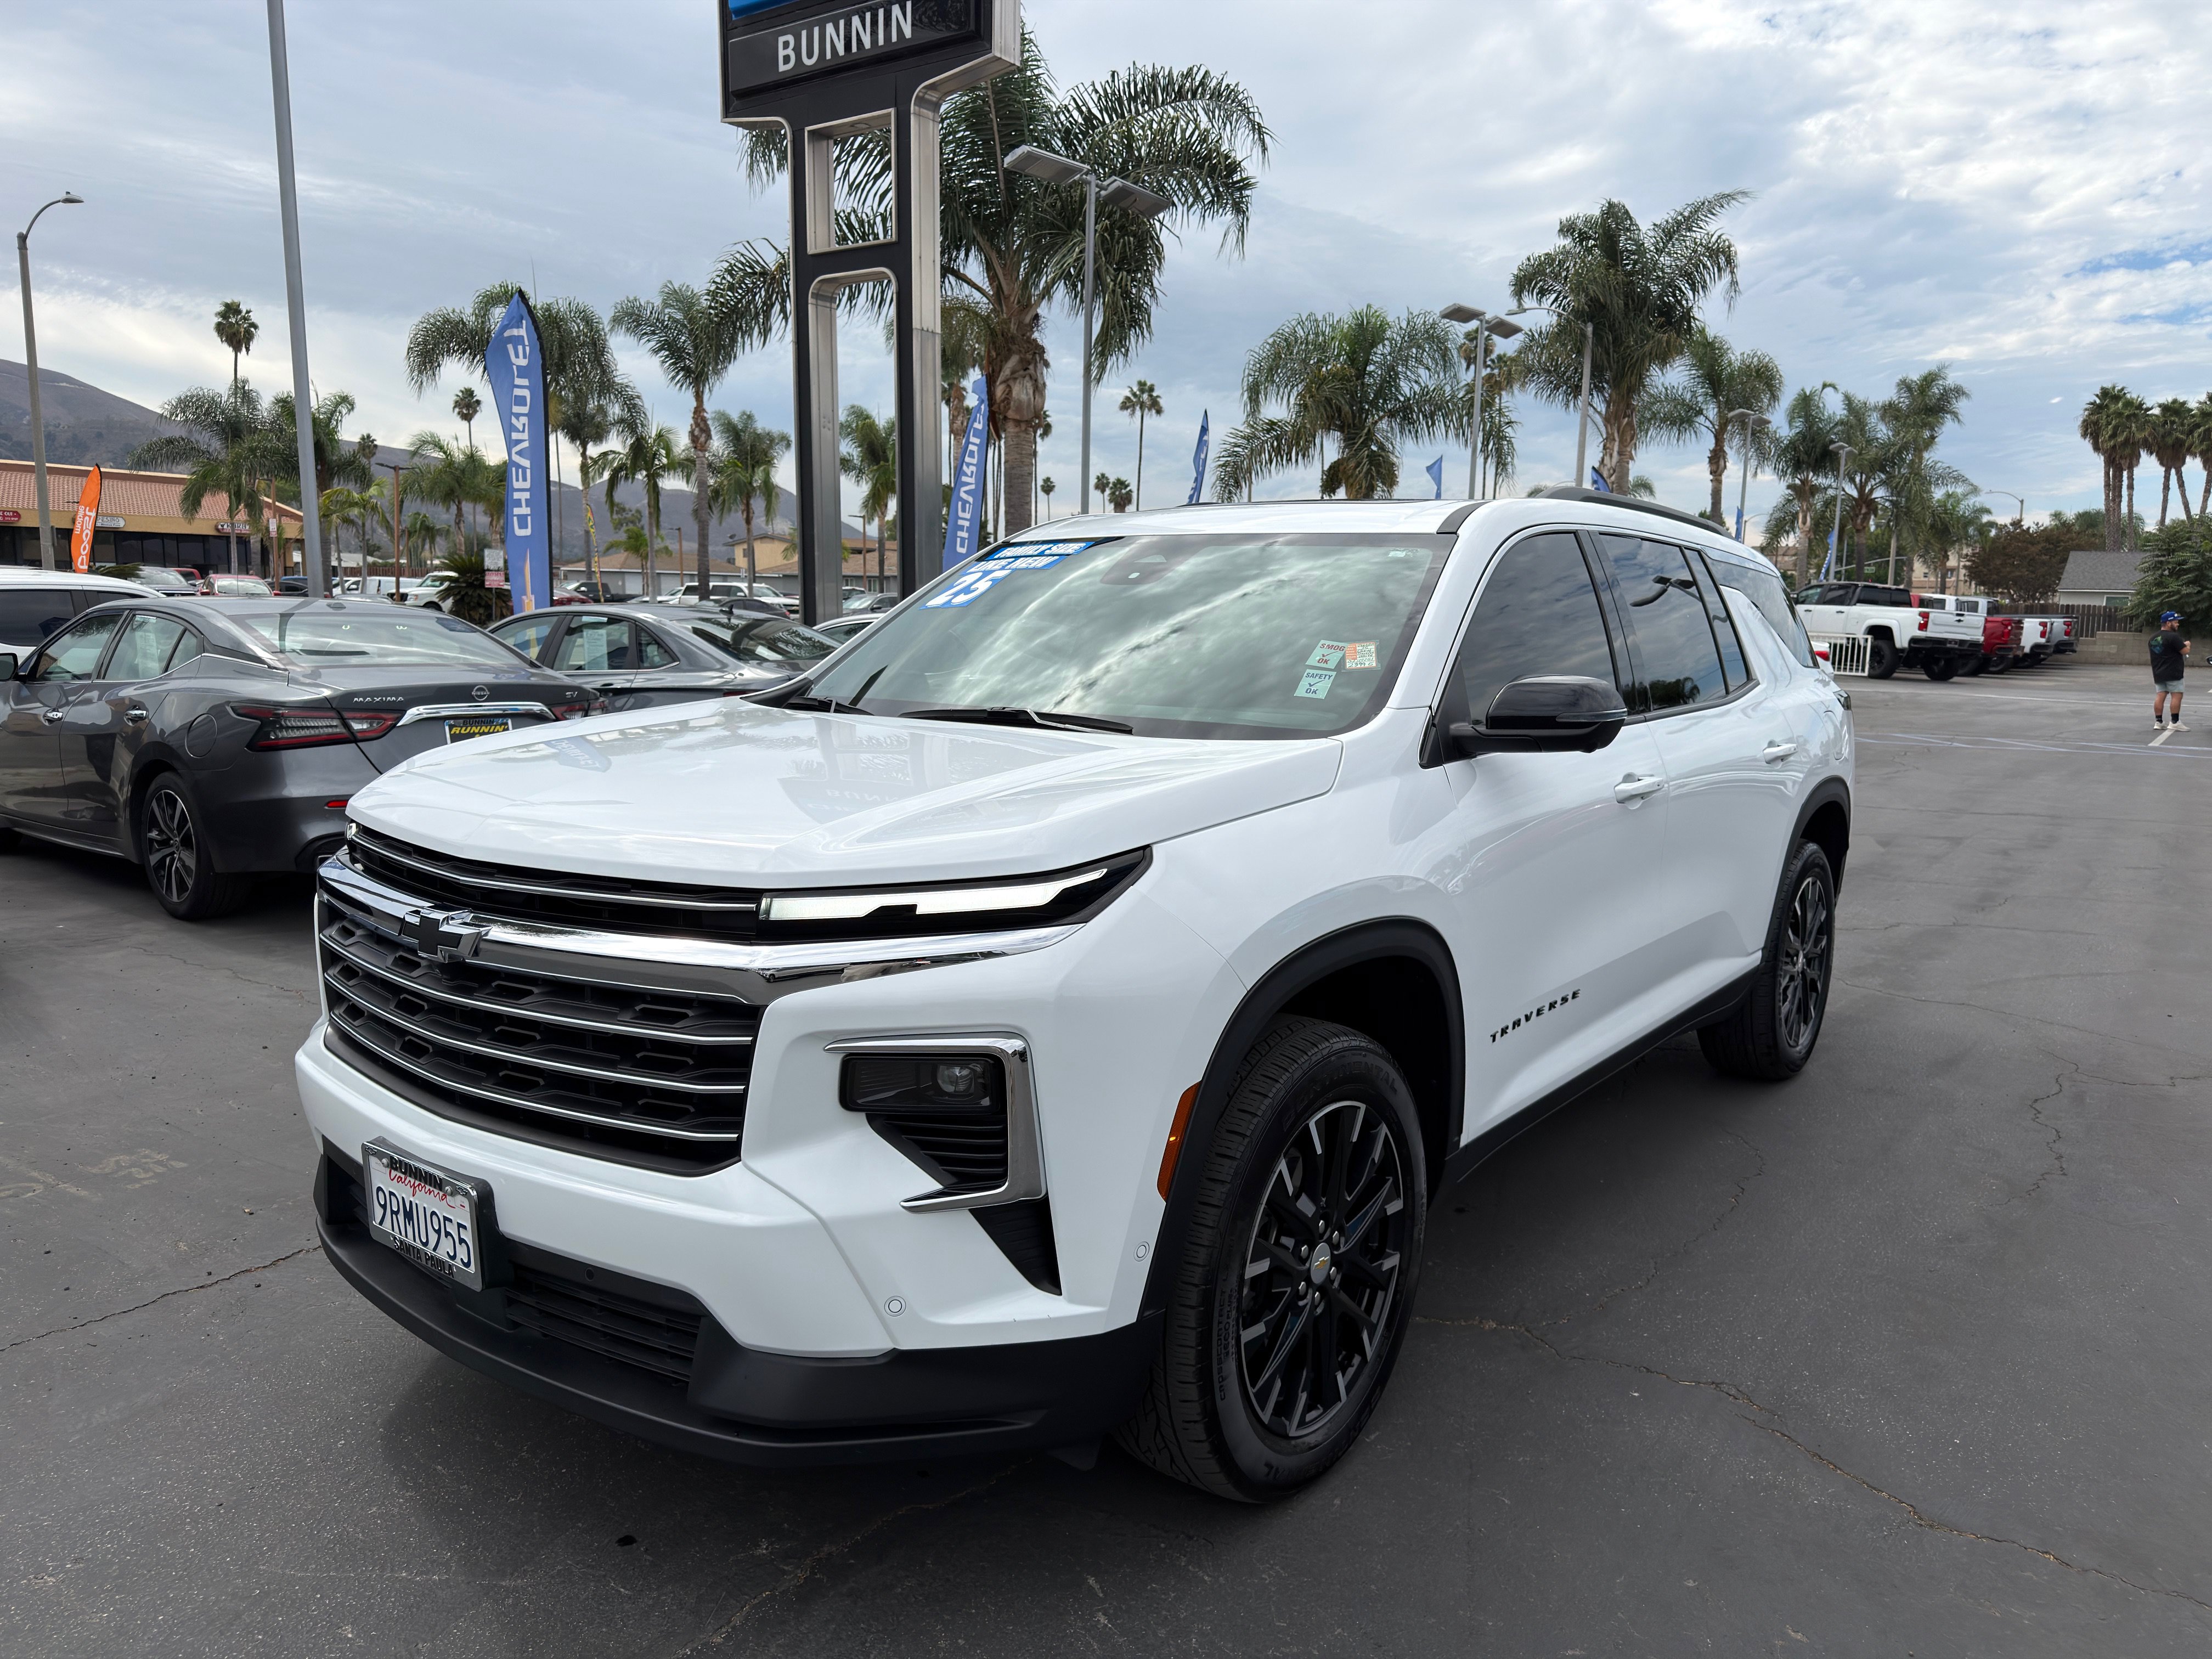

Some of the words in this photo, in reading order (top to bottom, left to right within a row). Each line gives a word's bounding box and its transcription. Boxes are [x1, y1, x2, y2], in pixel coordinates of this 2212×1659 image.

[777, 0, 913, 73] BUNNIN
[966, 558, 1014, 573] LIKE
[1005, 556, 1059, 569] NEW
[994, 545, 1054, 558] FAMILY
[1044, 543, 1086, 555] SIZE
[925, 569, 1013, 607] 25
[1490, 989, 1581, 1043] TRAVERSE
[388, 1168, 456, 1209] California
[390, 1155, 443, 1192] BUNNIN
[376, 1186, 471, 1268] 9RMU955
